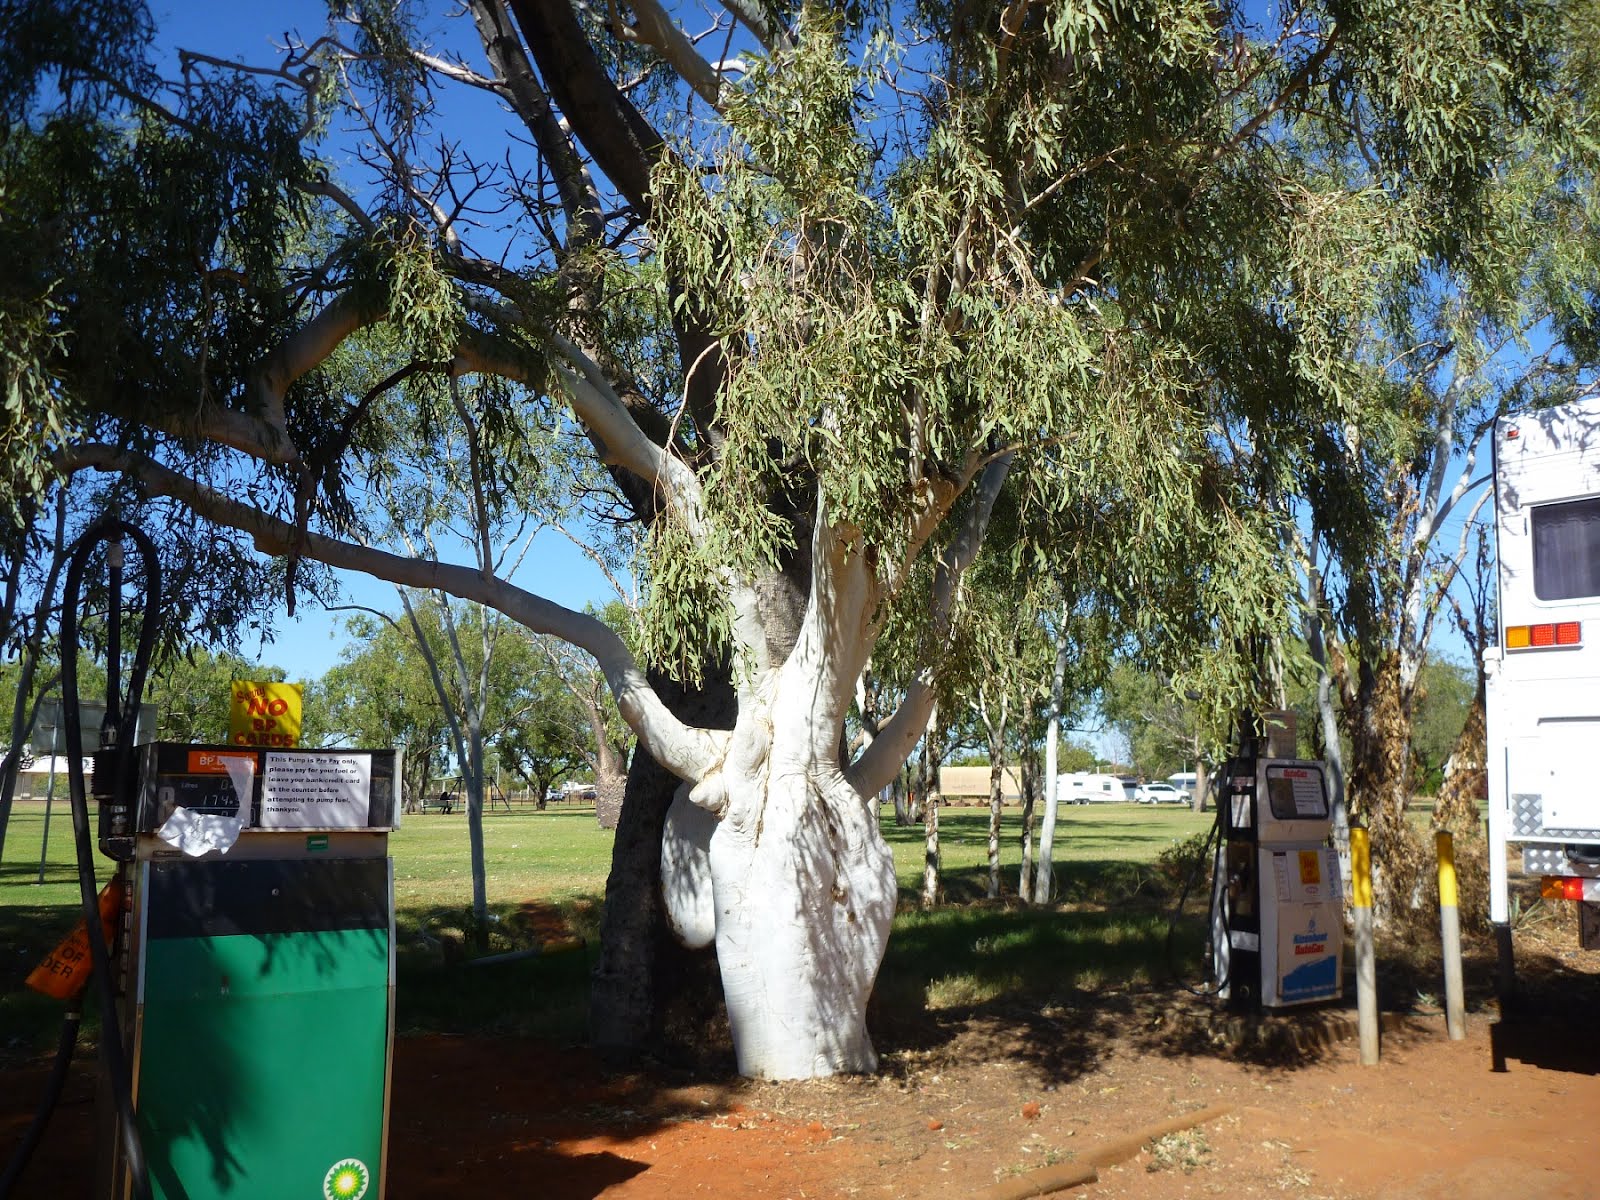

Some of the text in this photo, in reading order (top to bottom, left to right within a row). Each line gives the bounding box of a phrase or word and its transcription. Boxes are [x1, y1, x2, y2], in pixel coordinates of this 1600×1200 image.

[247, 698, 288, 716] NO
[253, 718, 277, 732] BP
[234, 732, 294, 747] CARDS
[199, 756, 213, 765] BP
[62, 946, 85, 962] OF
